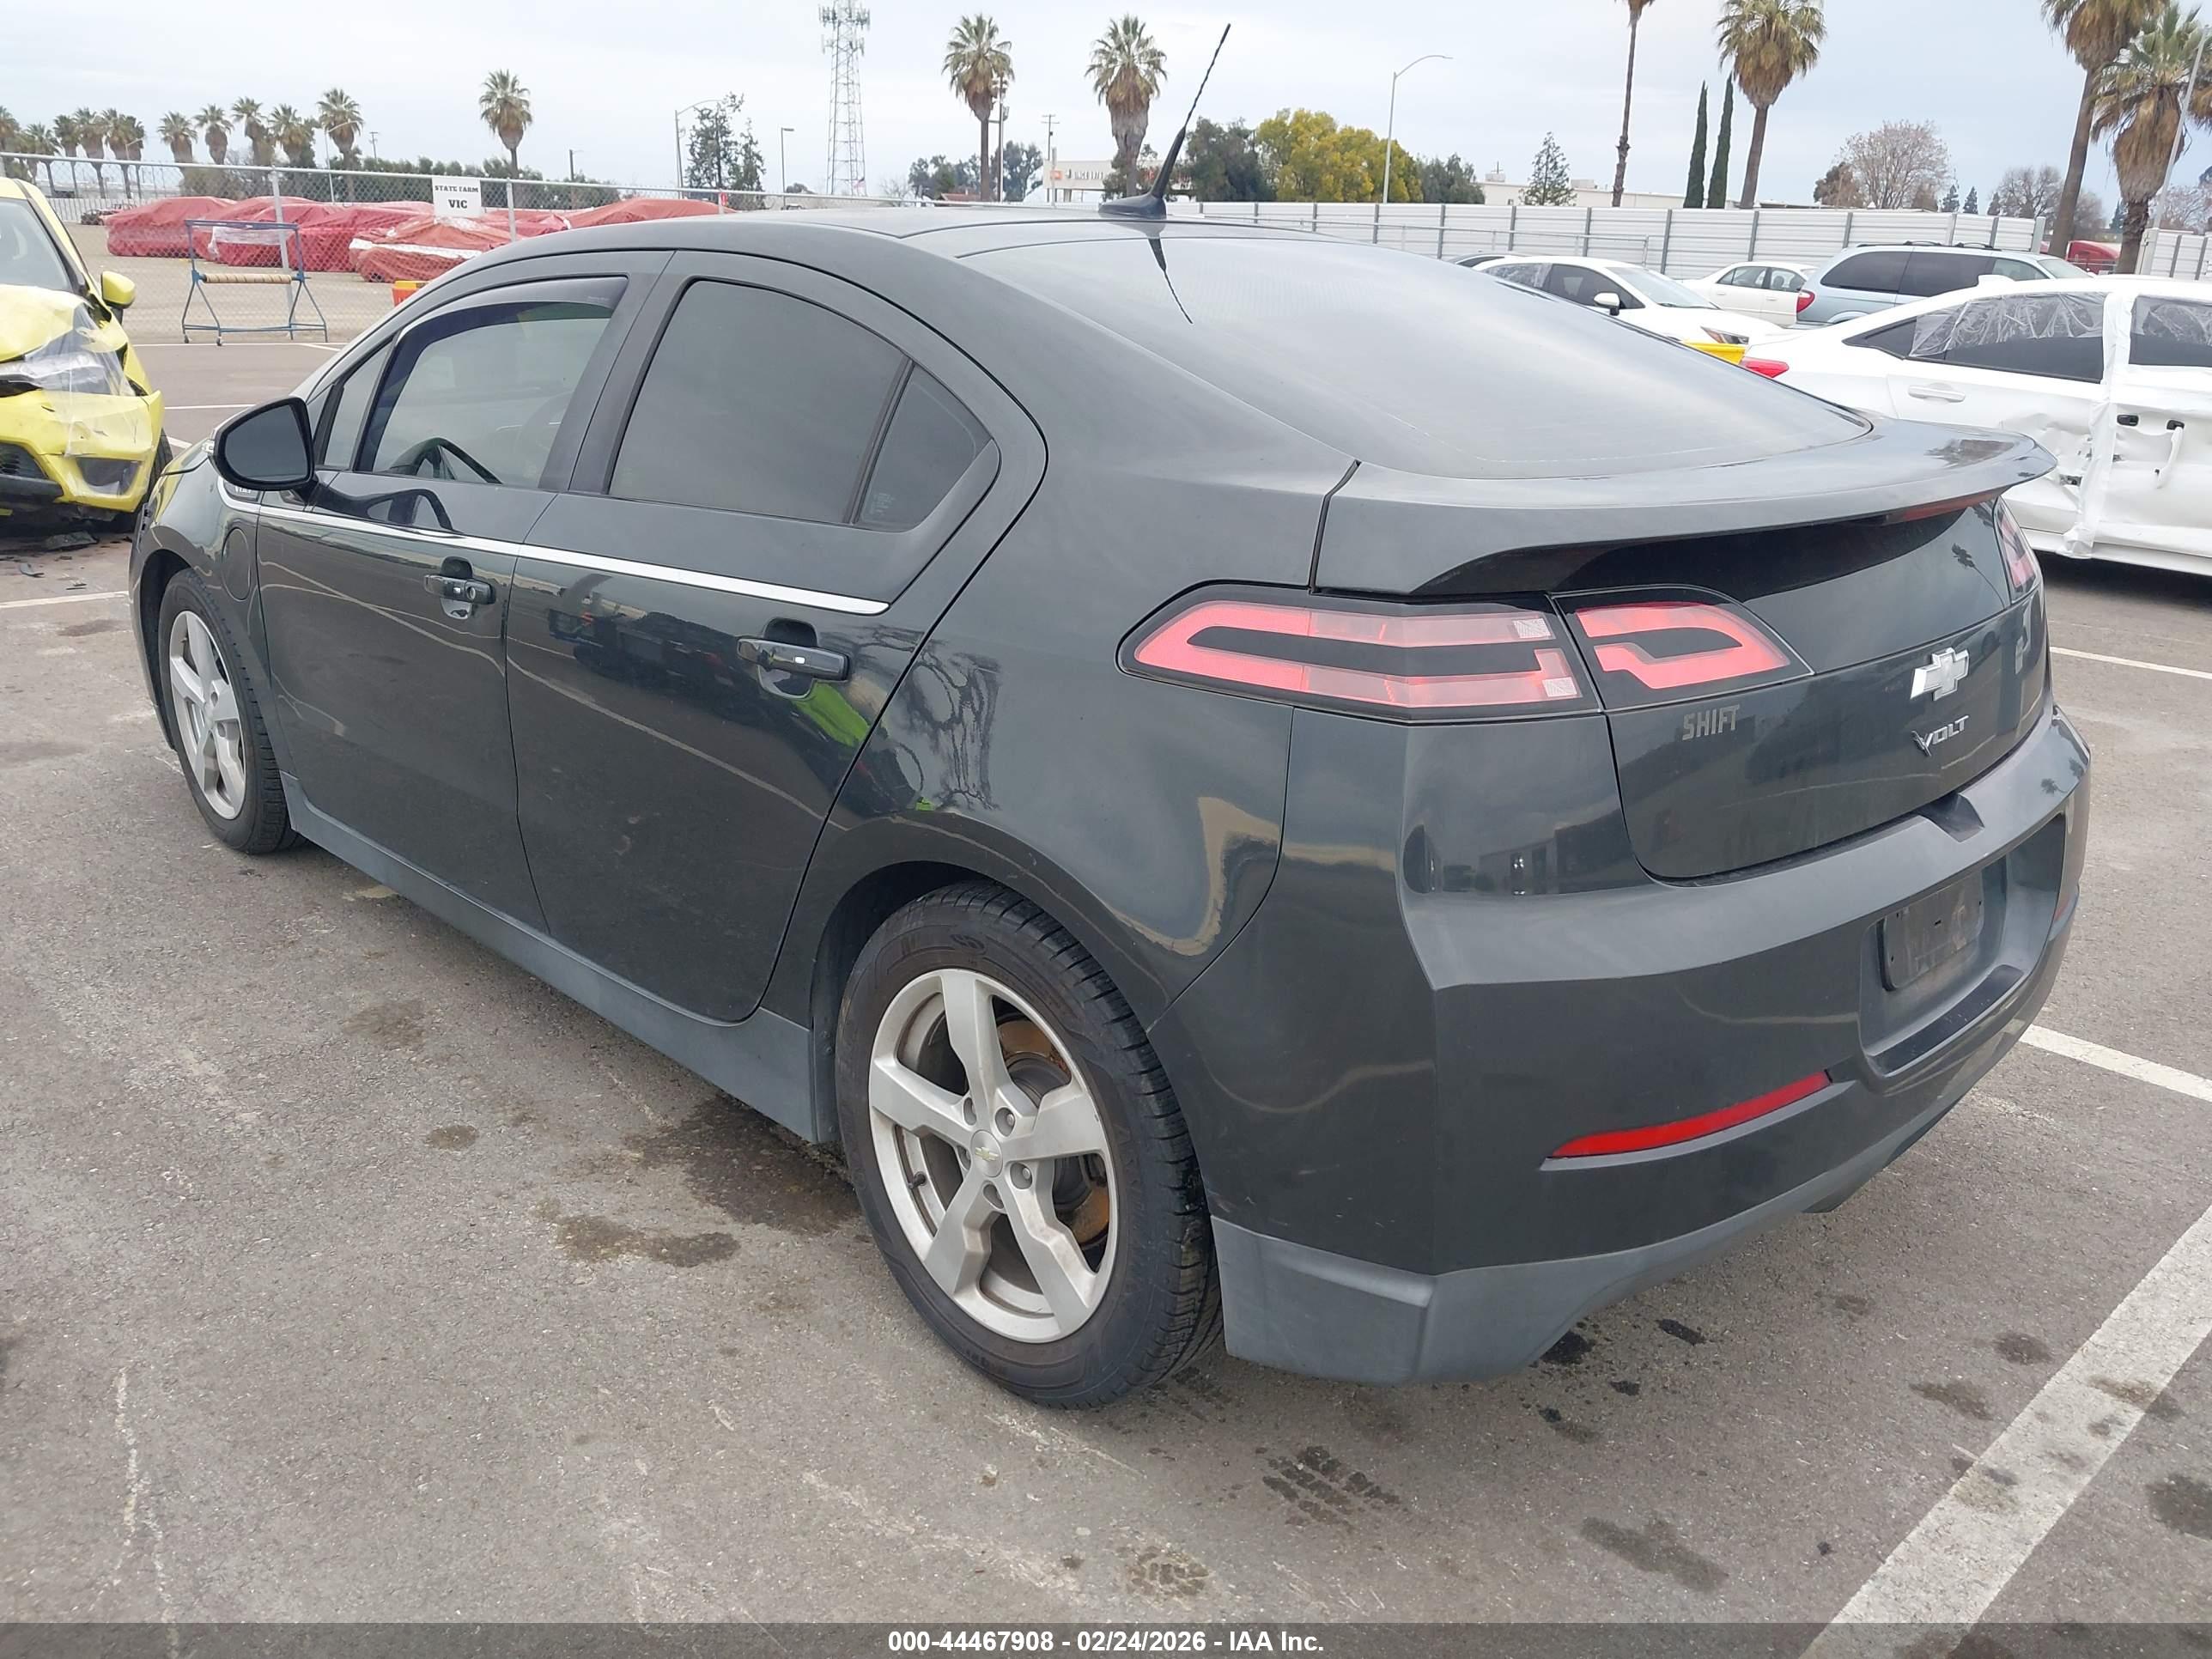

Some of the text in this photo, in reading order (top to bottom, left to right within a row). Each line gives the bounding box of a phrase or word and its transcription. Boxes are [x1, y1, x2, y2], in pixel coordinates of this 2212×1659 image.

[448, 199, 468, 209] VIC
[1682, 704, 1740, 740] SHIFT
[1911, 715, 1969, 757] VOLT
